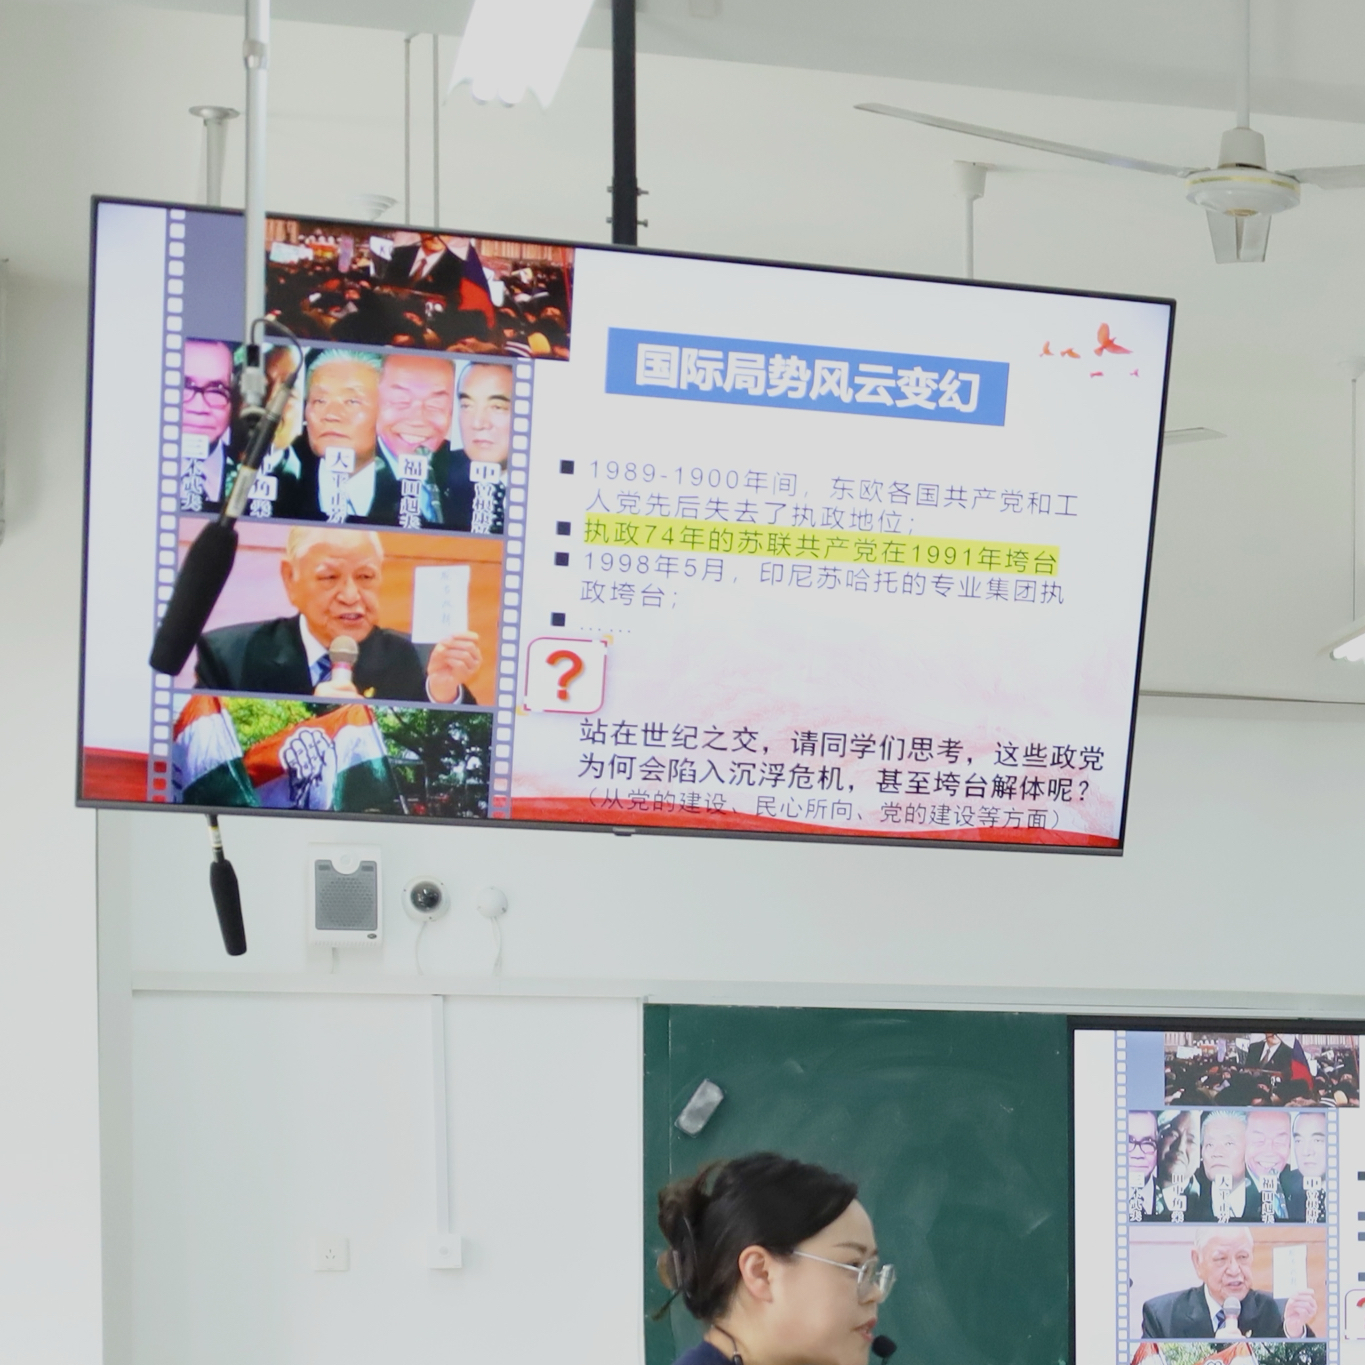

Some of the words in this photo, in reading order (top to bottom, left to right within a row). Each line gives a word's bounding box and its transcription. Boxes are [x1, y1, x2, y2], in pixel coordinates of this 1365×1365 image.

[635, 343, 980, 413] 国际局势风云变幻
[584, 519, 1058, 575] 执政74年的苏联共产党在1991年垮台
